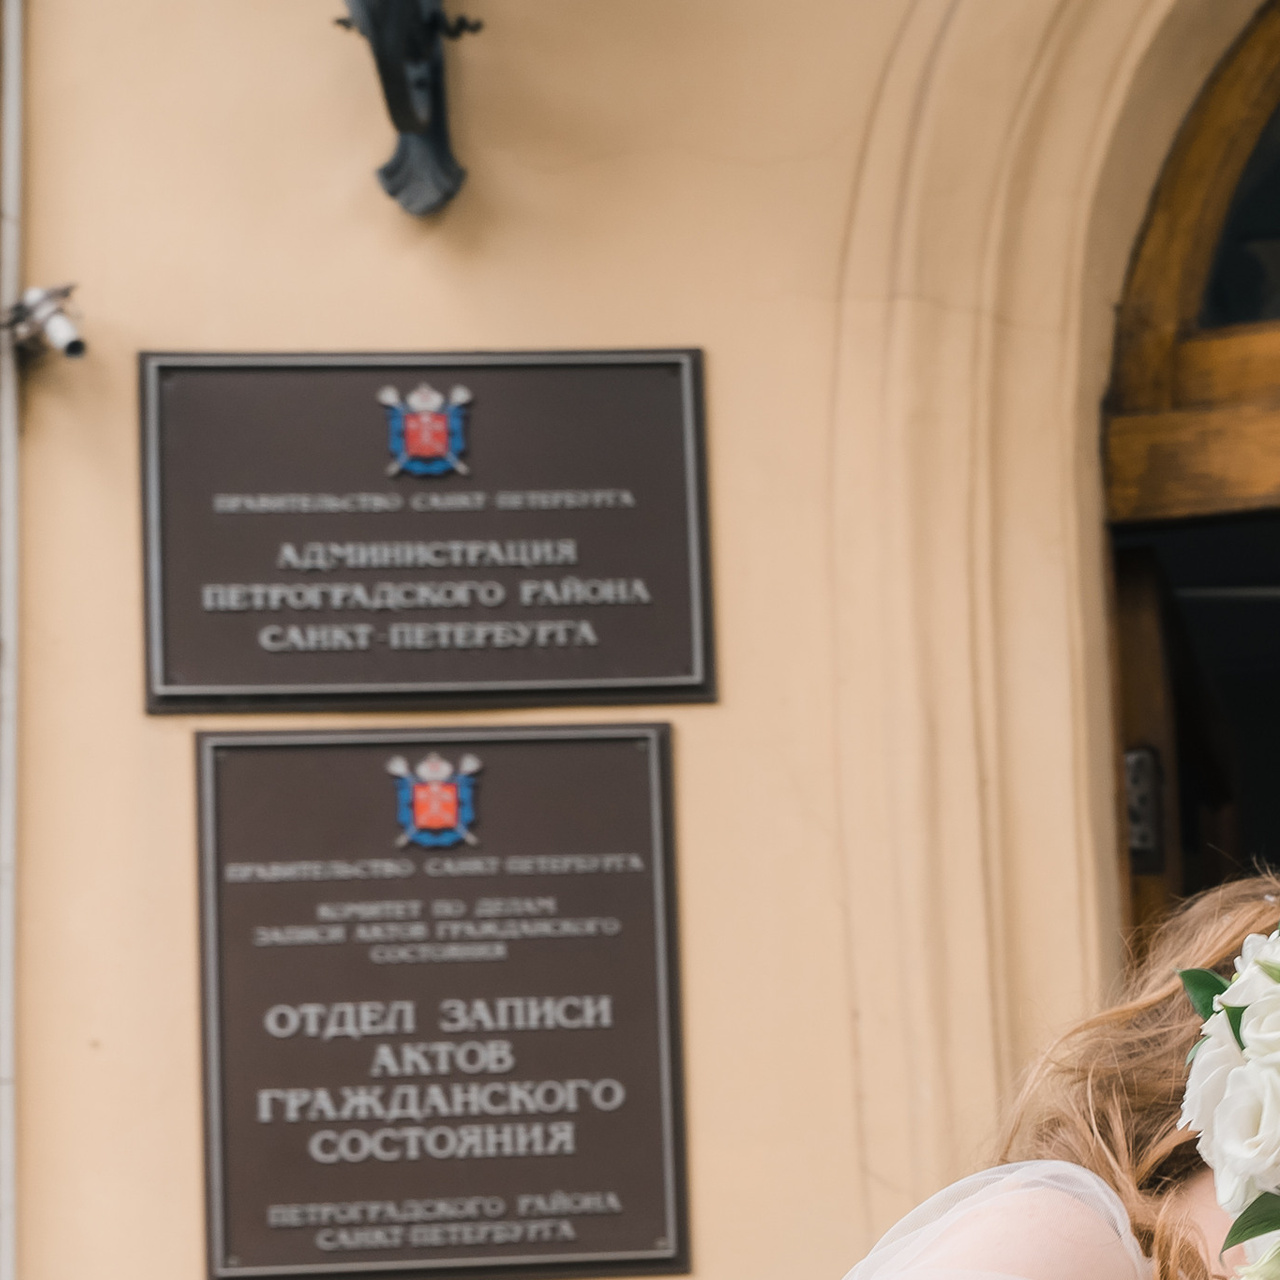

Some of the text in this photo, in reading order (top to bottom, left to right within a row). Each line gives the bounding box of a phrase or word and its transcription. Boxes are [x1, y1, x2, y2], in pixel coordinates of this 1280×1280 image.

[278, 540, 576, 569] АДМИНИСТРАЦИЯ
[202, 575, 649, 610] ПЕТРОГРАДСКОГО РАЙОНА
[263, 995, 612, 1040] ОТДЕЛ ЗАПИСИ
[370, 1040, 514, 1077] АКТОВ
[257, 1079, 625, 1122] ГРАЖДАНСКОГО
[308, 1121, 574, 1163] СОСТОЯНИЯ
